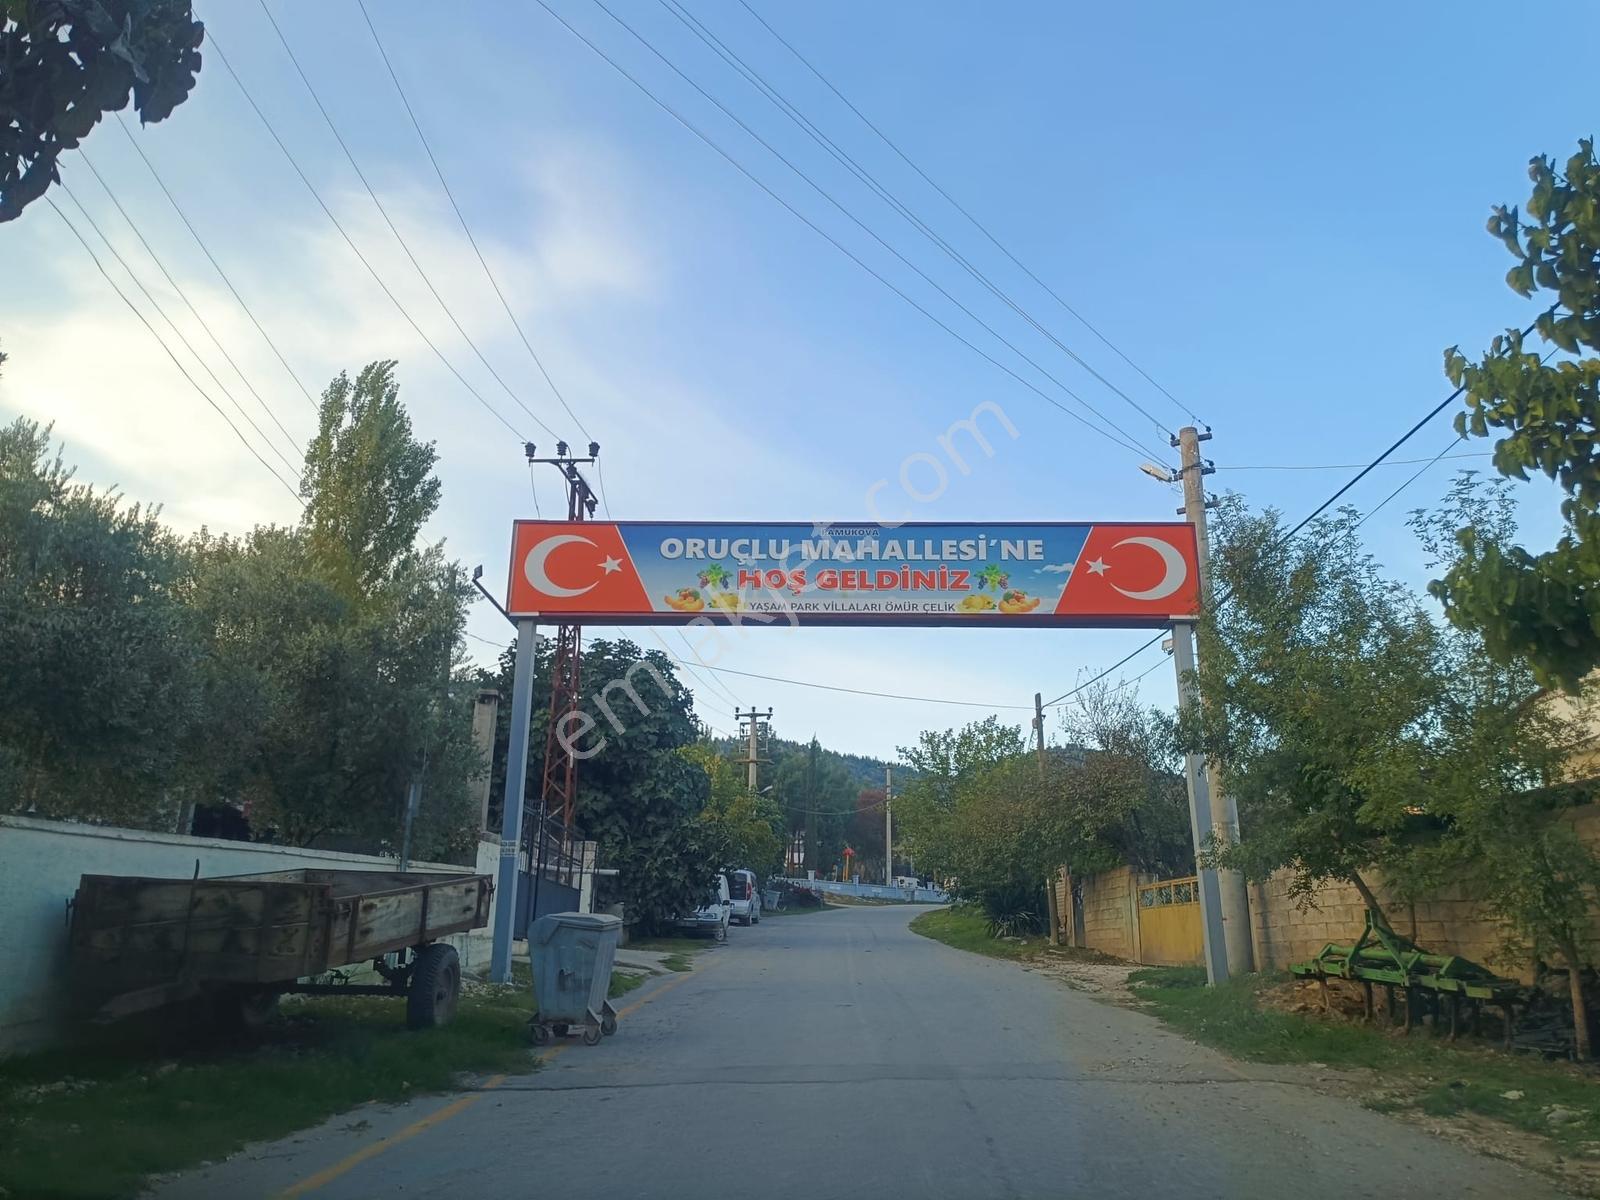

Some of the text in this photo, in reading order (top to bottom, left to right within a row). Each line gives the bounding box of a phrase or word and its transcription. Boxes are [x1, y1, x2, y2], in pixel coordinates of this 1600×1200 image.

[659, 537, 790, 565] ORUÇLU
[737, 564, 971, 596] HOŞ GELDİNİZ
[750, 601, 787, 612] YAŞAM
[790, 602, 819, 612] PARK
[886, 600, 919, 612] ÖMÜR
[922, 600, 956, 614] ÇELİK
